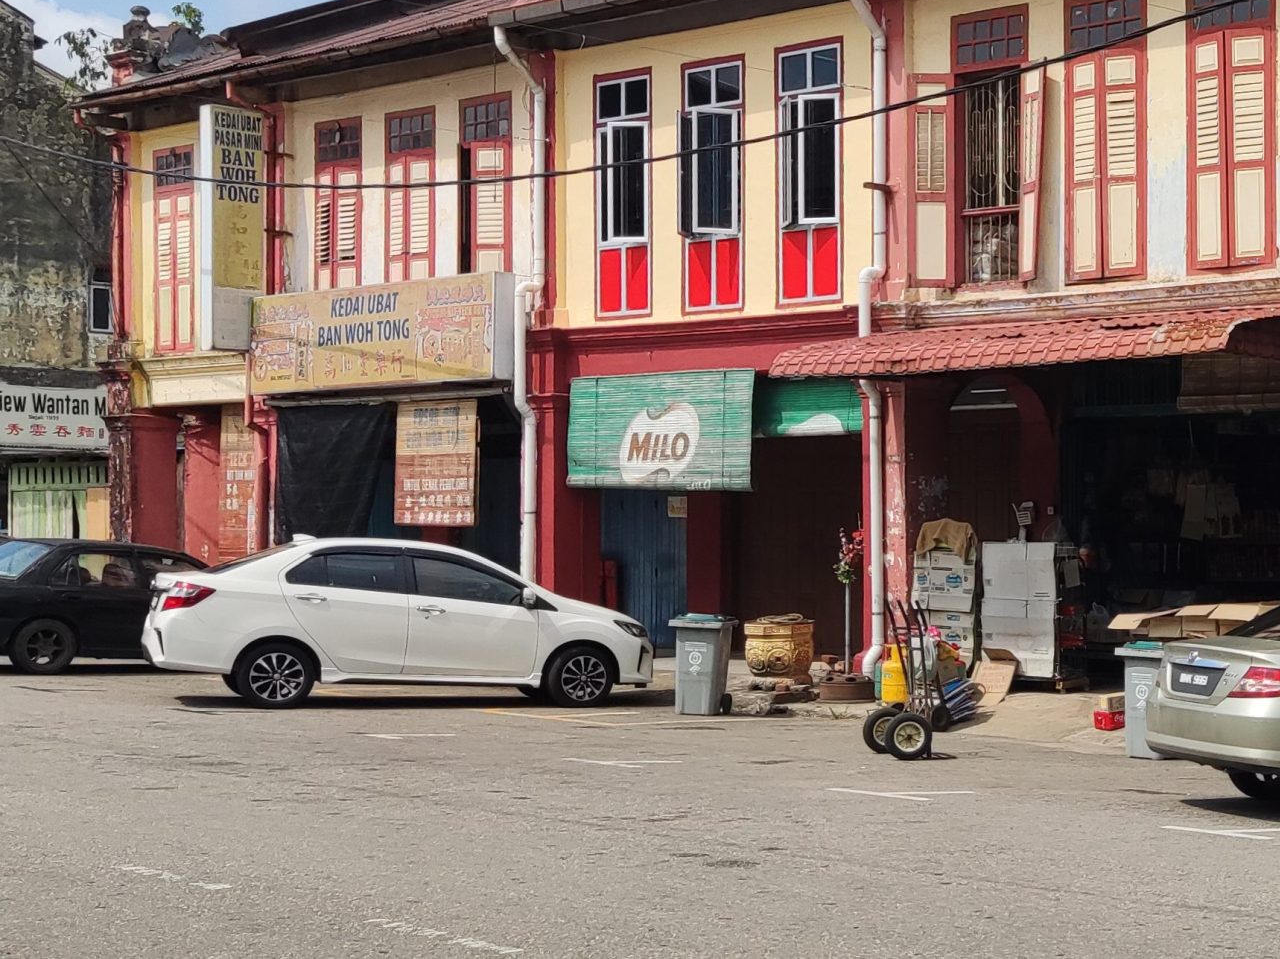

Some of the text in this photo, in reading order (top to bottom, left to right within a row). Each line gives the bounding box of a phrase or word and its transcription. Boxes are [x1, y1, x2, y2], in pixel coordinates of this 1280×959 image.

[214, 111, 262, 133] KEDAI UBAT
[214, 128, 262, 151] PASAR MINI
[221, 148, 255, 167] BAN
[220, 166, 257, 182] WOH
[216, 183, 260, 204] TONG
[330, 296, 365, 319] KEDAI
[367, 292, 399, 315] UBAT
[318, 318, 410, 347] BAN WOH TONG
[32, 393, 89, 416] Wantan
[626, 431, 690, 462] MILO
